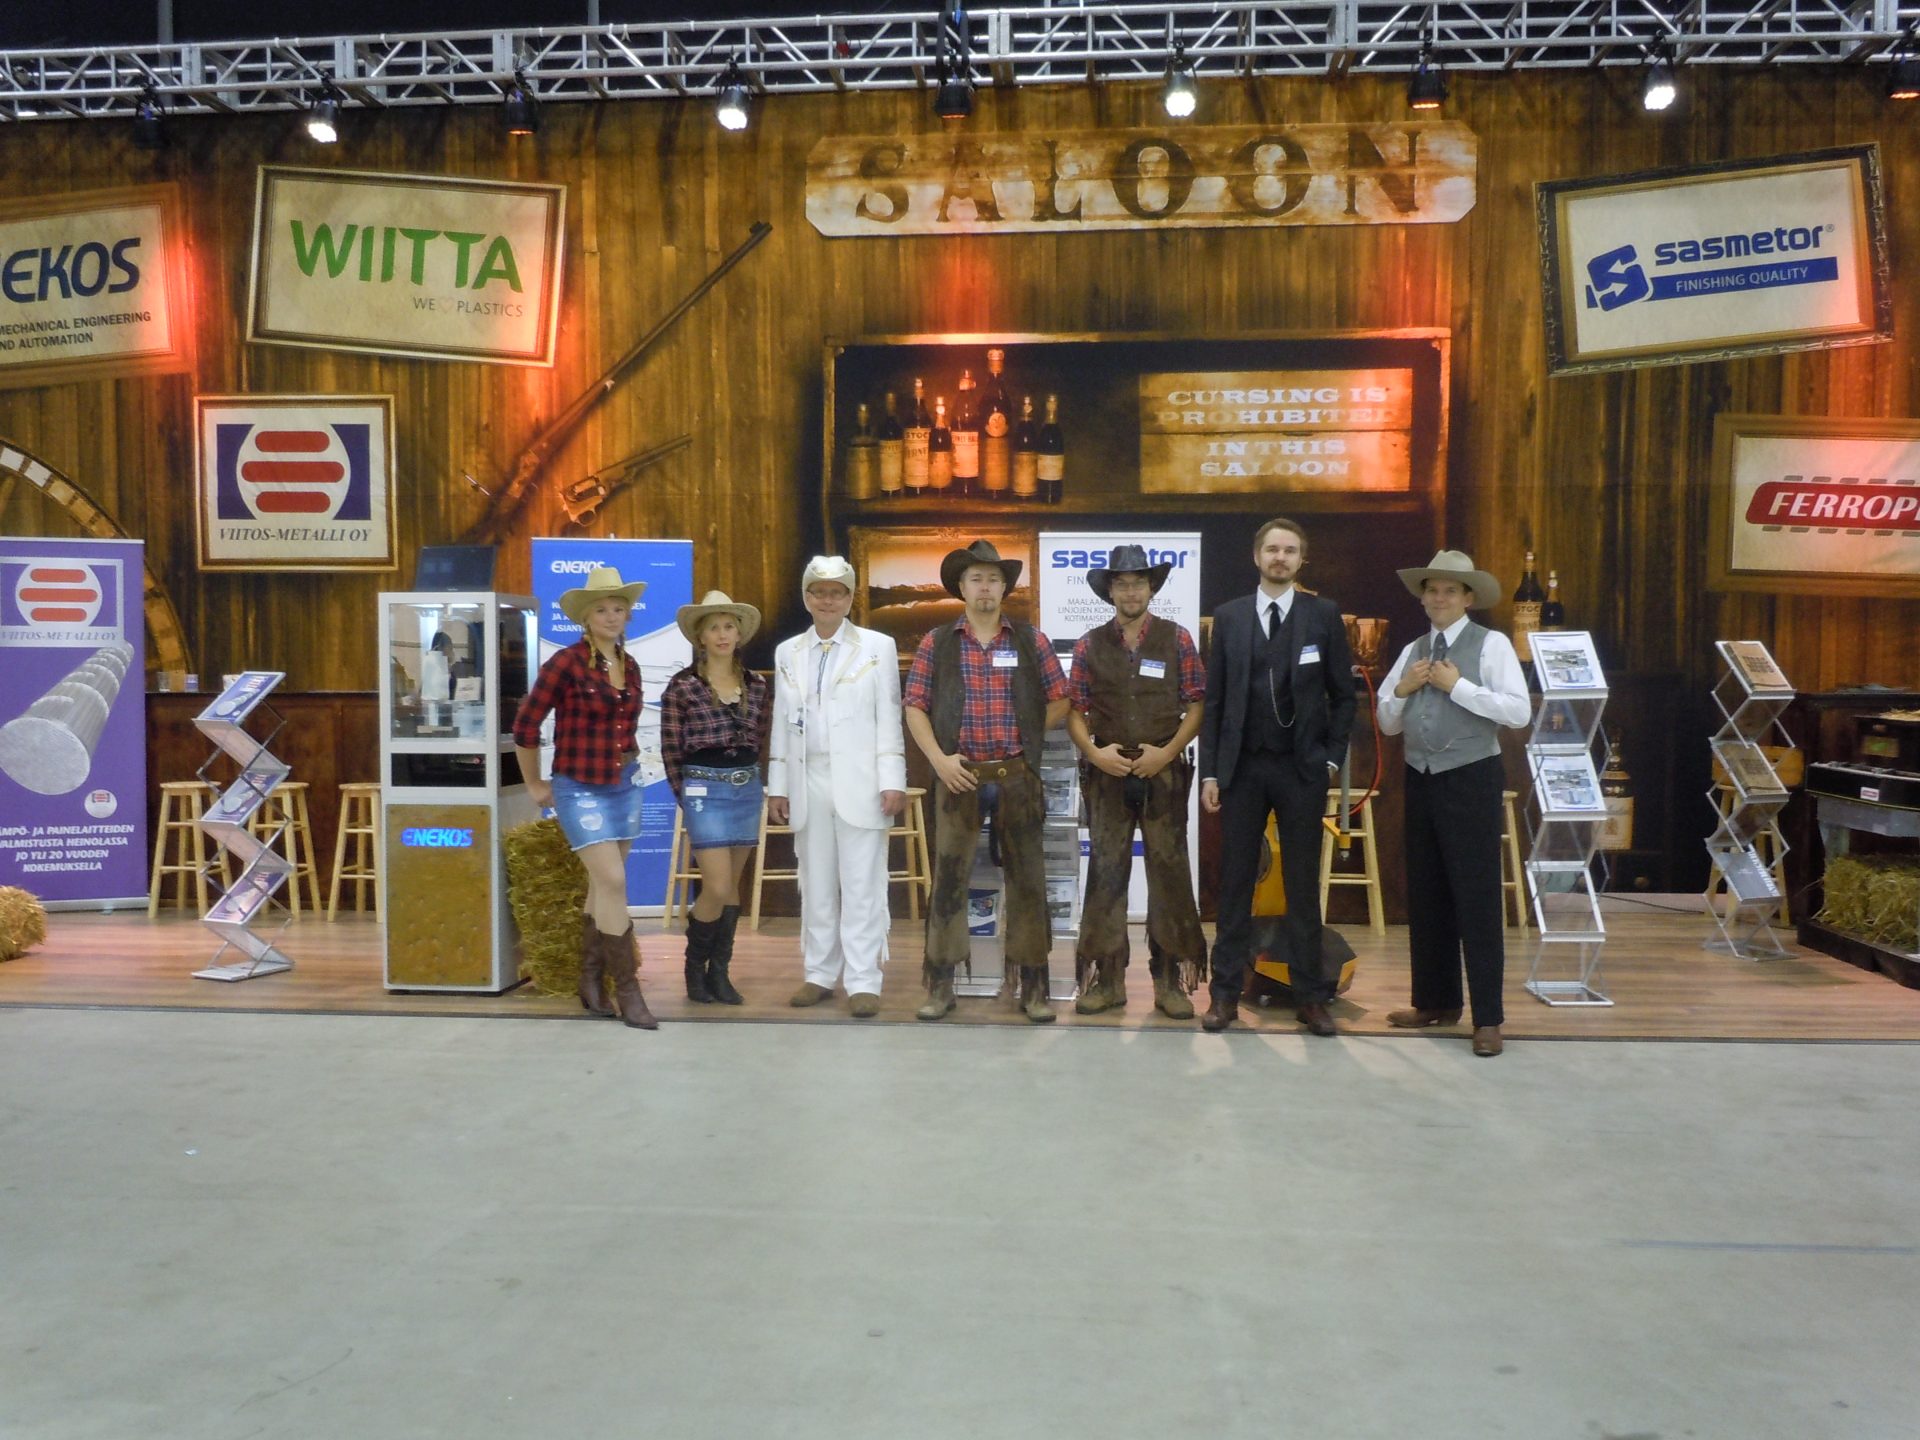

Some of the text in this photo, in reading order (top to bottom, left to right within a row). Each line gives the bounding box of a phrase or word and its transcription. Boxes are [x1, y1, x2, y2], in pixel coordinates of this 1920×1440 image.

[854, 130, 1423, 223] SALOON
[1654, 224, 1825, 267] sasmetor
[290, 219, 524, 294] WIITTA
[0, 237, 142, 304] EKOS
[1675, 264, 1810, 294] FINISHING QUALITY
[413, 296, 524, 318] WE PLASTICS
[73, 311, 152, 329] ENGINEERING
[19, 332, 94, 351] AUTOMATION
[1167, 387, 1388, 406] CURSING IS
[1154, 408, 1397, 425] PROHIBITED
[906, 431, 929, 439] STOC
[1206, 439, 1346, 457] IN THIS
[1200, 460, 1351, 477] SALOON
[219, 528, 371, 542] VIITOS-METALLI OY
[1052, 548, 1188, 569] sastor
[1515, 605, 1539, 613] STOC
[46, 824, 135, 835] PAINELAITTEIDEN
[401, 827, 474, 847] ENEKOS
[66, 836, 129, 847] HEINOLASSA
[65, 849, 110, 860] VUODEN
[23, 861, 103, 873] KOKEMUKSELLA
